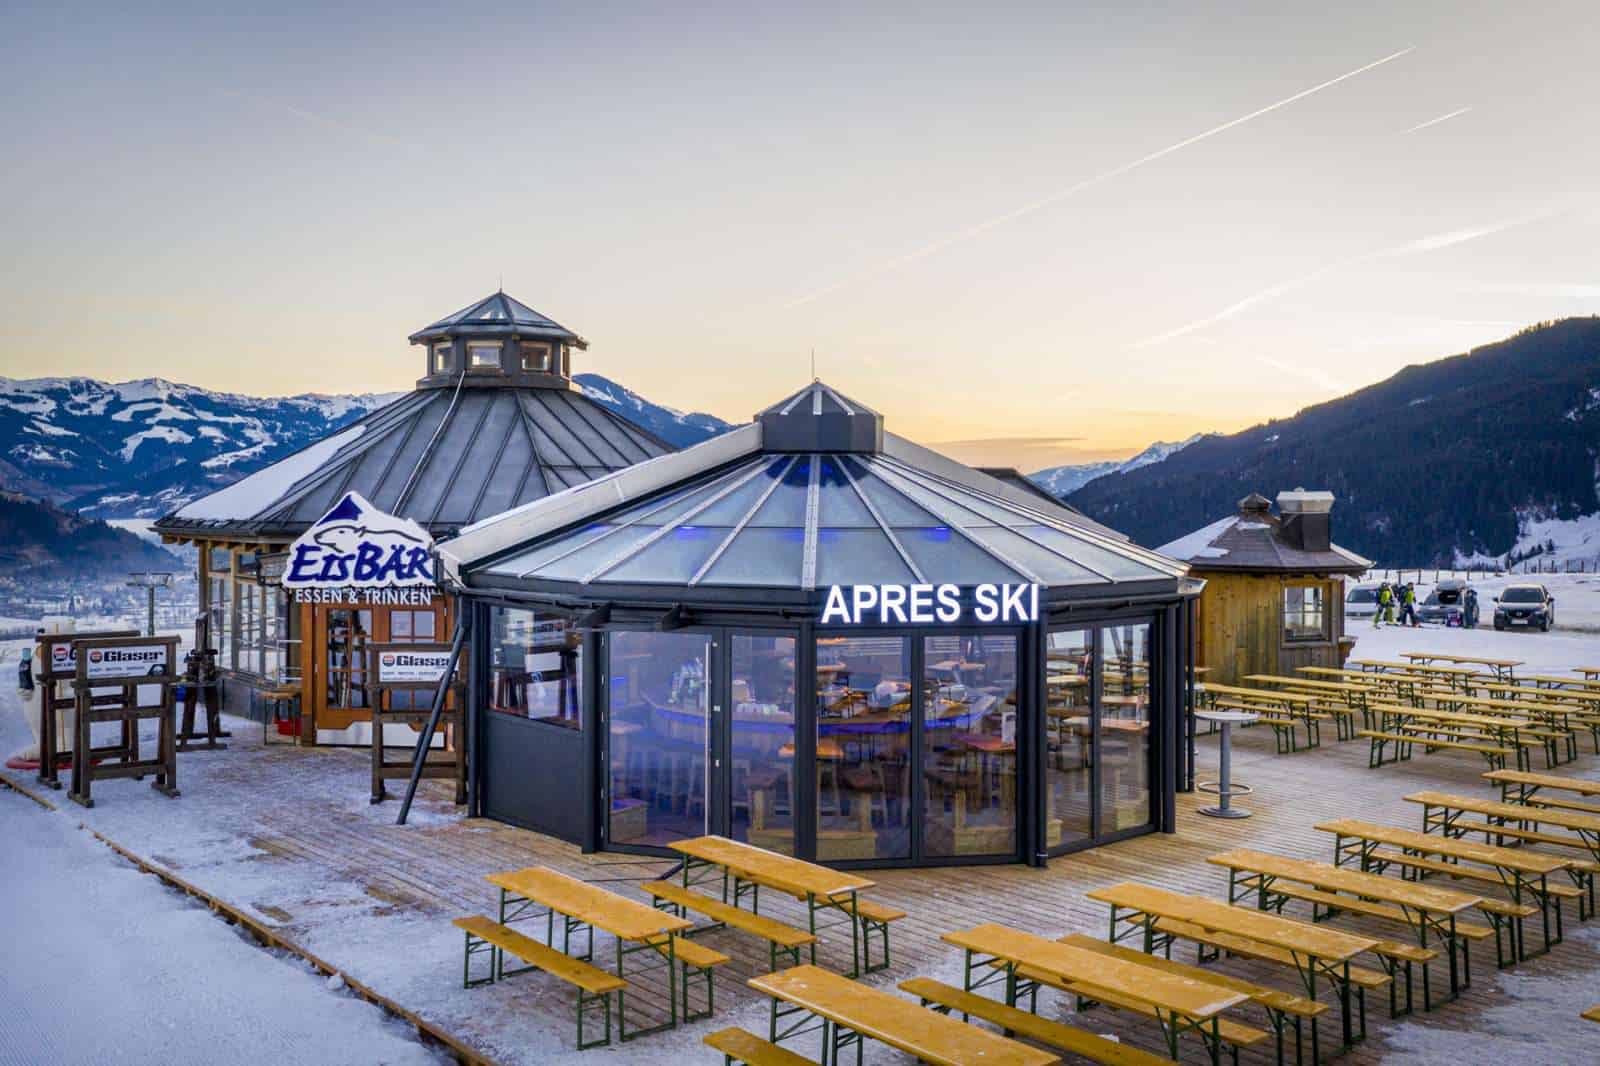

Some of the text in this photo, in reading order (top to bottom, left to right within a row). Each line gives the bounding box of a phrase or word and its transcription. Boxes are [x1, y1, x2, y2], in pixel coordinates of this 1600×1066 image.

[296, 589, 432, 606] ESSEN & TRINKEN
[820, 583, 1040, 624] APRES SKI
[103, 651, 163, 662] Glaser
[396, 655, 450, 667] Glase
